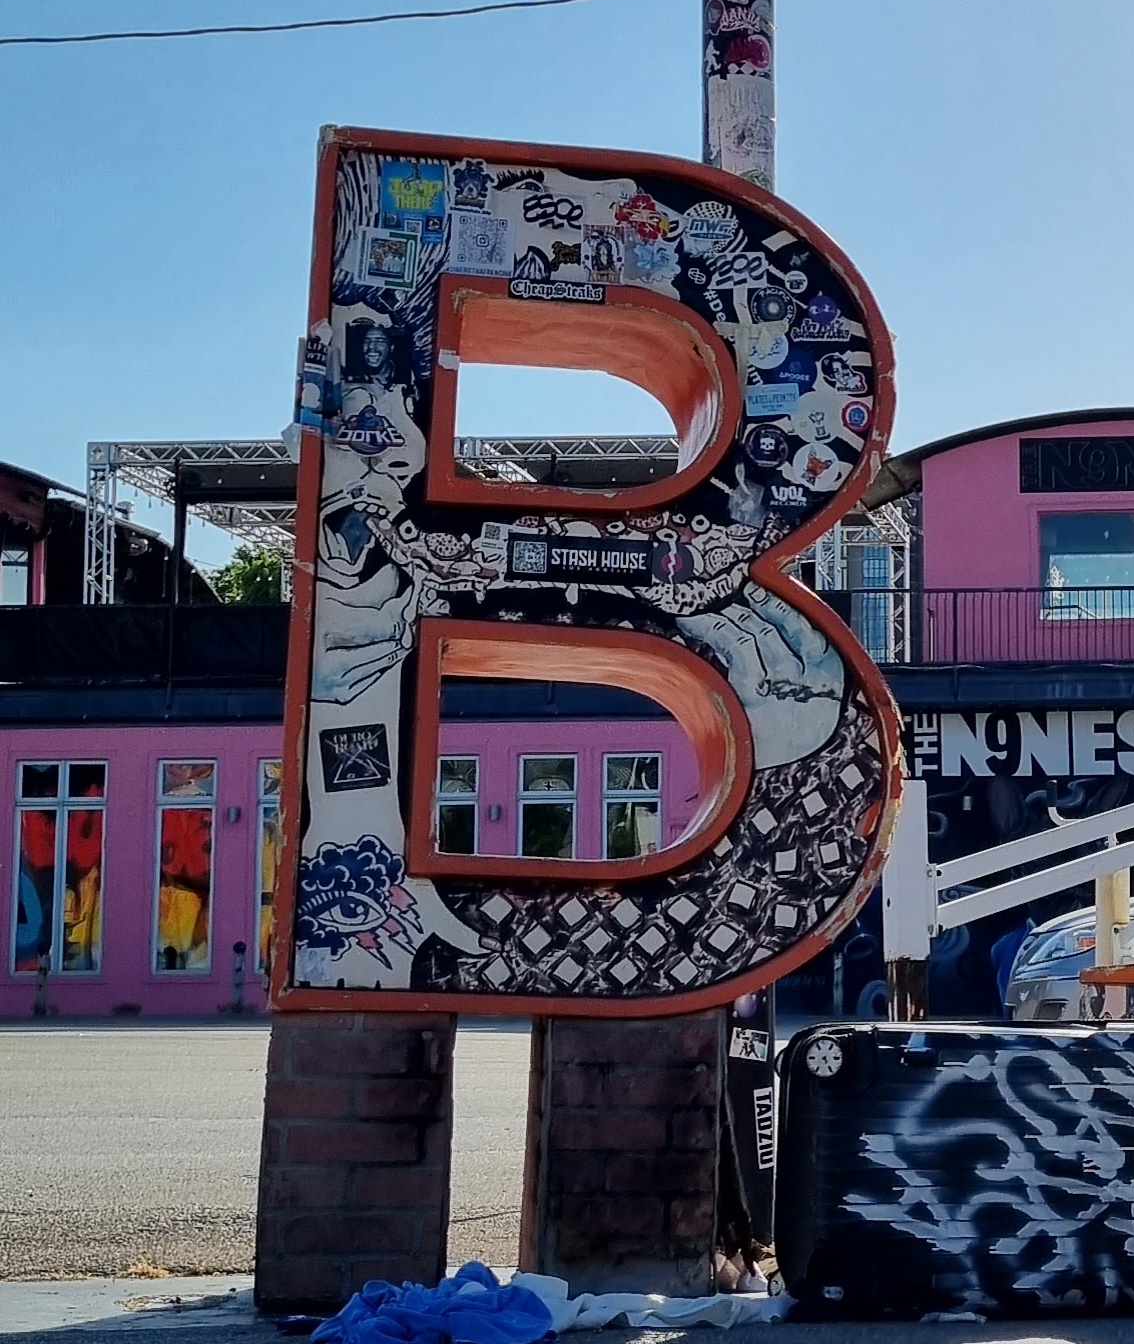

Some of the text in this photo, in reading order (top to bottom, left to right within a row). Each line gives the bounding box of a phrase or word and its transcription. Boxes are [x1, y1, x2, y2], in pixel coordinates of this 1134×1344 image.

[510, 278, 604, 302] CheapSteaks
[779, 371, 811, 382] APOGEE
[551, 548, 647, 570] STASH HOUSE
[913, 713, 938, 777] THE
